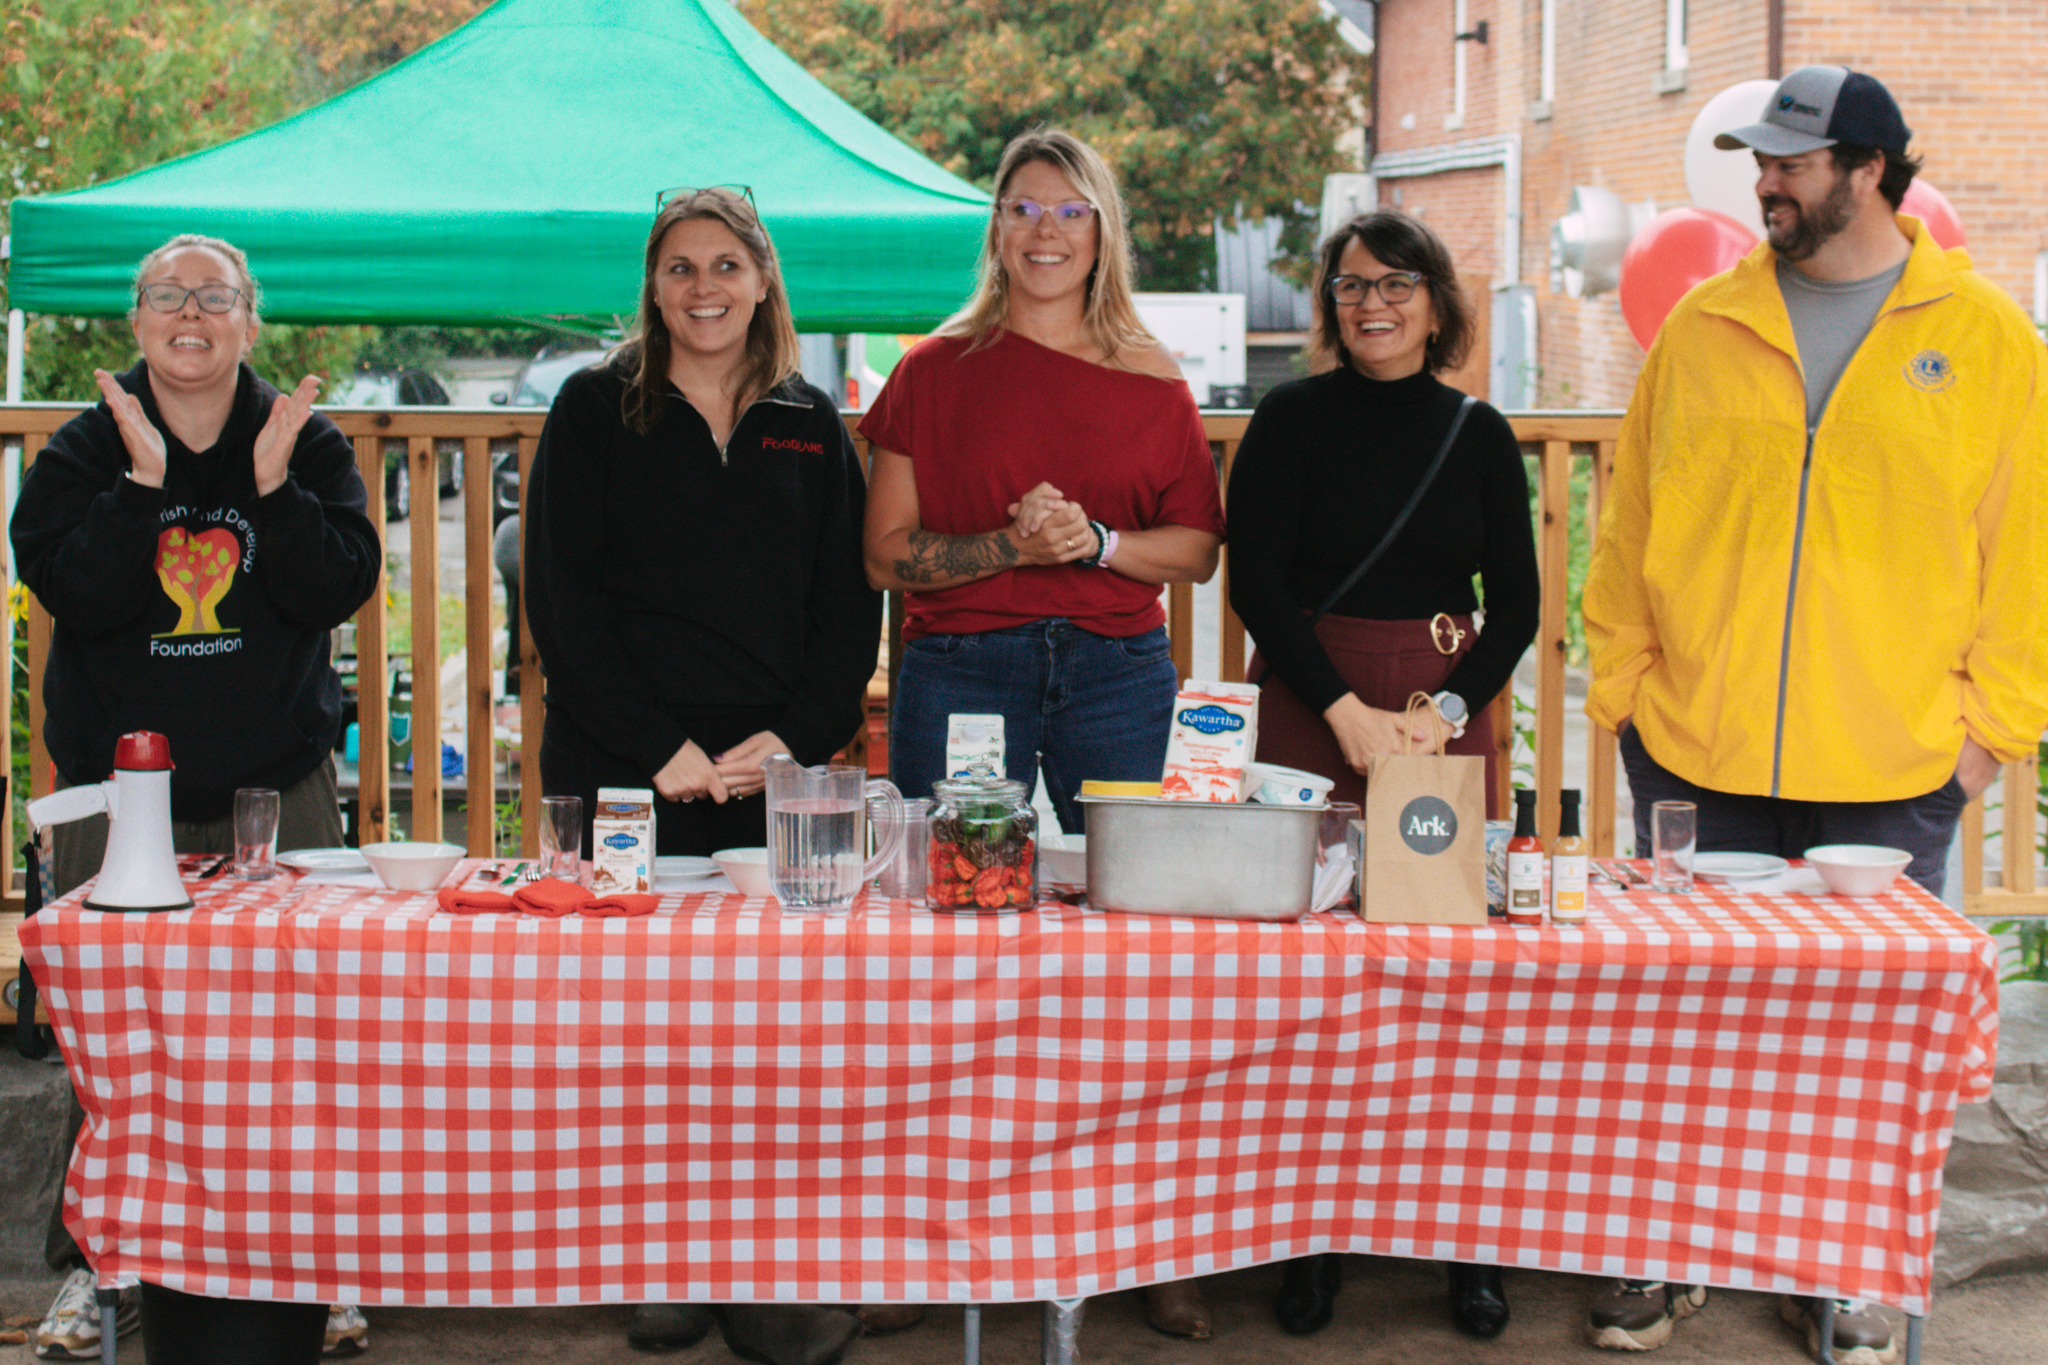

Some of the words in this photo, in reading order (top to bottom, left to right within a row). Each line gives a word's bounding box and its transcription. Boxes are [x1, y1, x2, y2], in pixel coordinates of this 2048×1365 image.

[762, 437, 824, 455] FOODLAND
[225, 508, 257, 573] Develop
[151, 637, 242, 656] Foundation
[1182, 711, 1241, 728] Kawartha
[1407, 815, 1450, 836] Ark.
